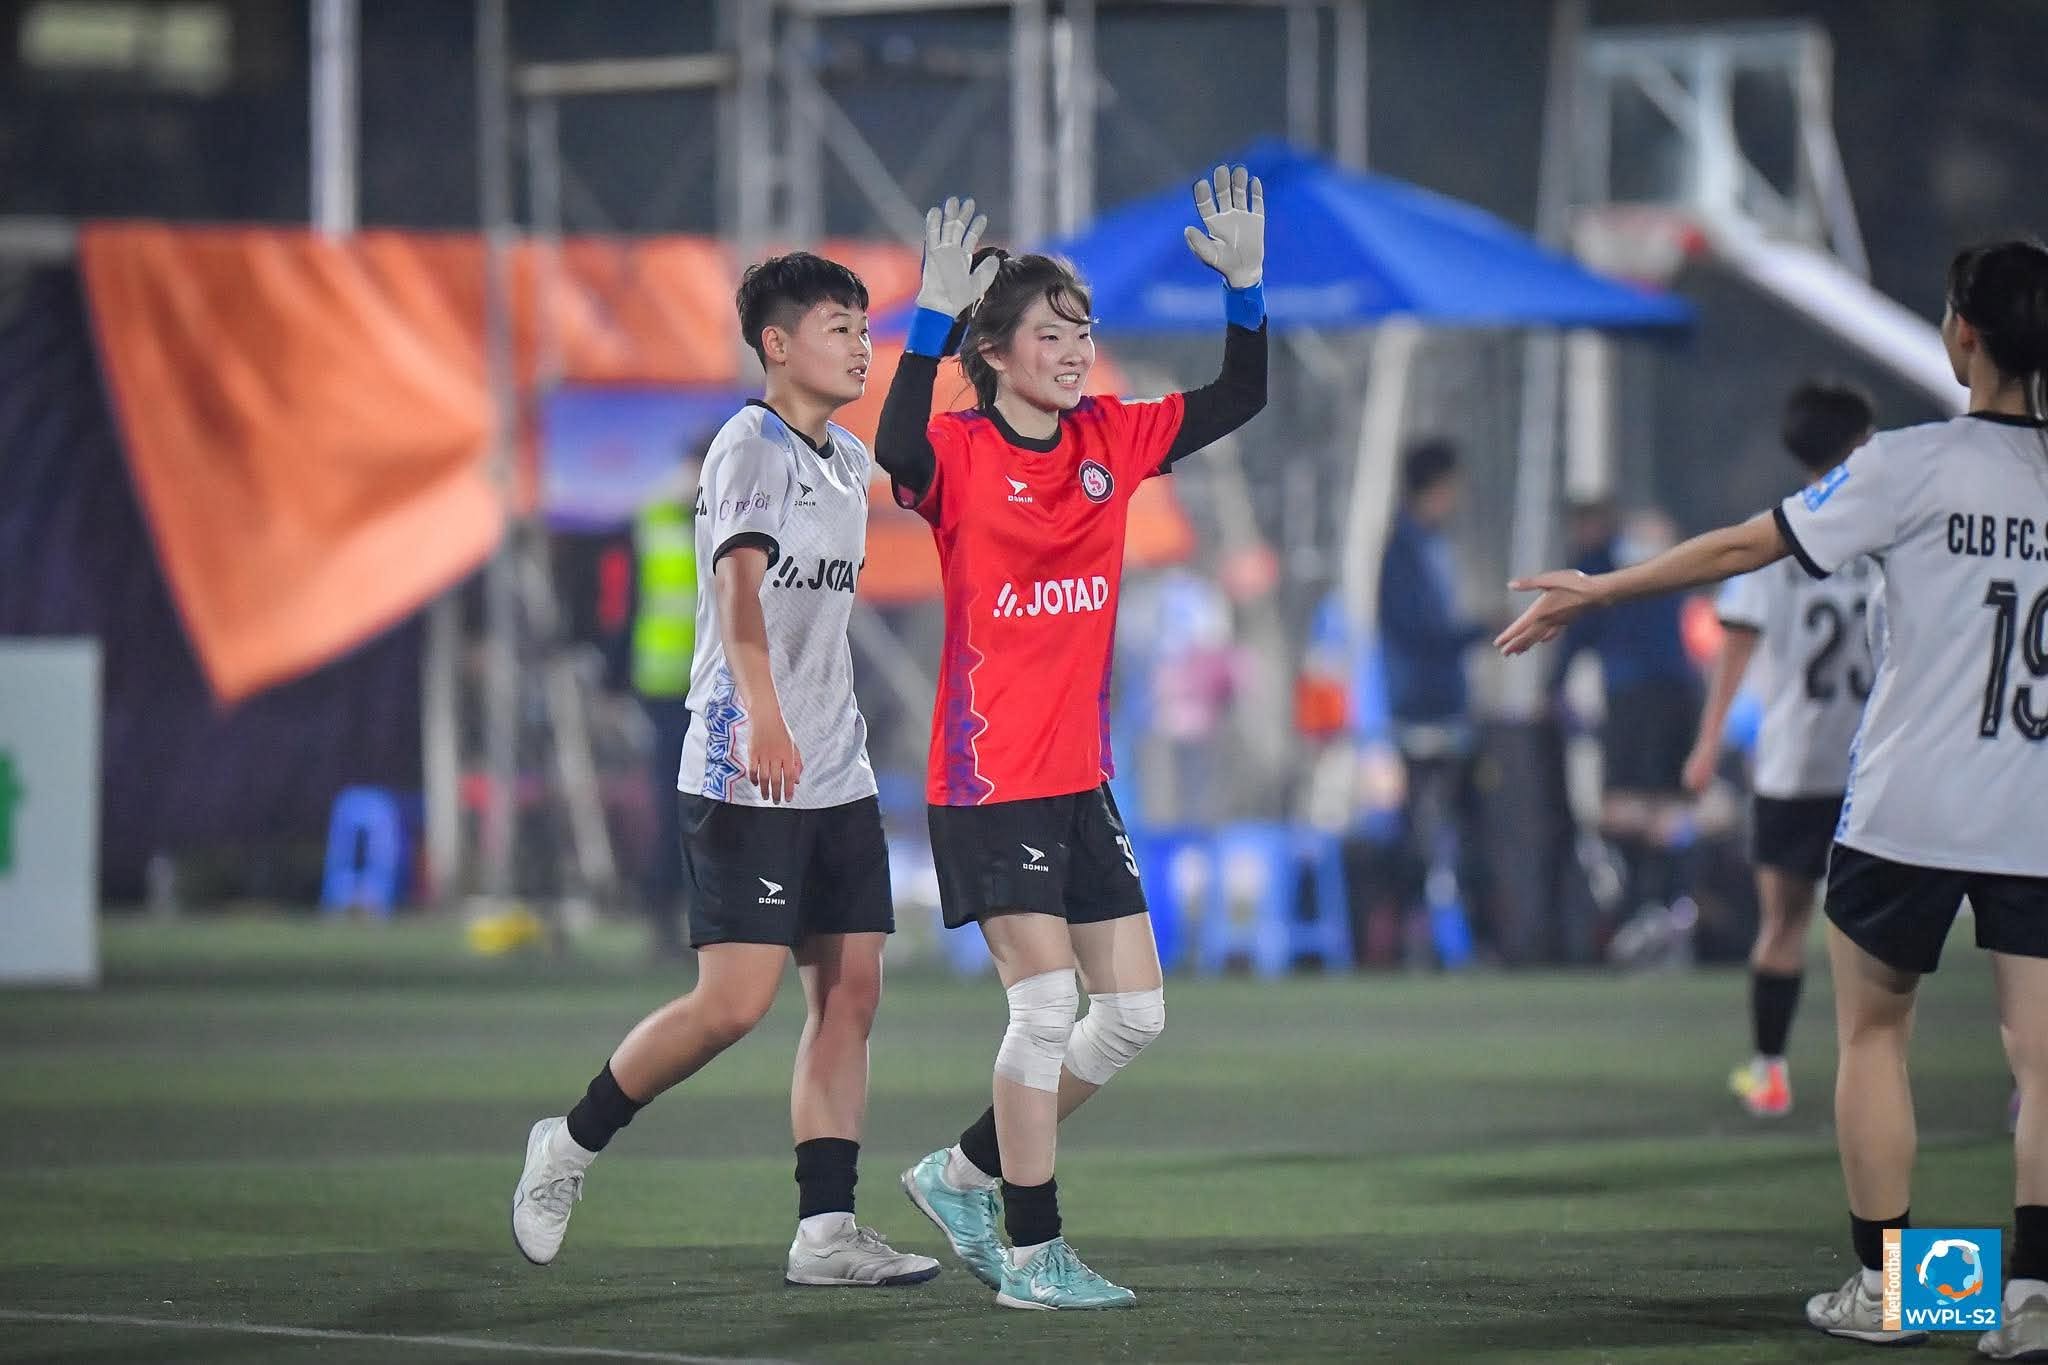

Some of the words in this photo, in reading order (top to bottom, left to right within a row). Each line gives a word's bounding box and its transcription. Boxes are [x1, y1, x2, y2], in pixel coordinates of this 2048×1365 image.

[1948, 512, 1995, 557] CLB
[807, 558, 855, 593] JOTA
[1026, 576, 1109, 617] JOTAD
[1979, 579, 2048, 740] 19
[1023, 863, 1049, 872] DOMIN
[758, 897, 786, 905] DOMIN
